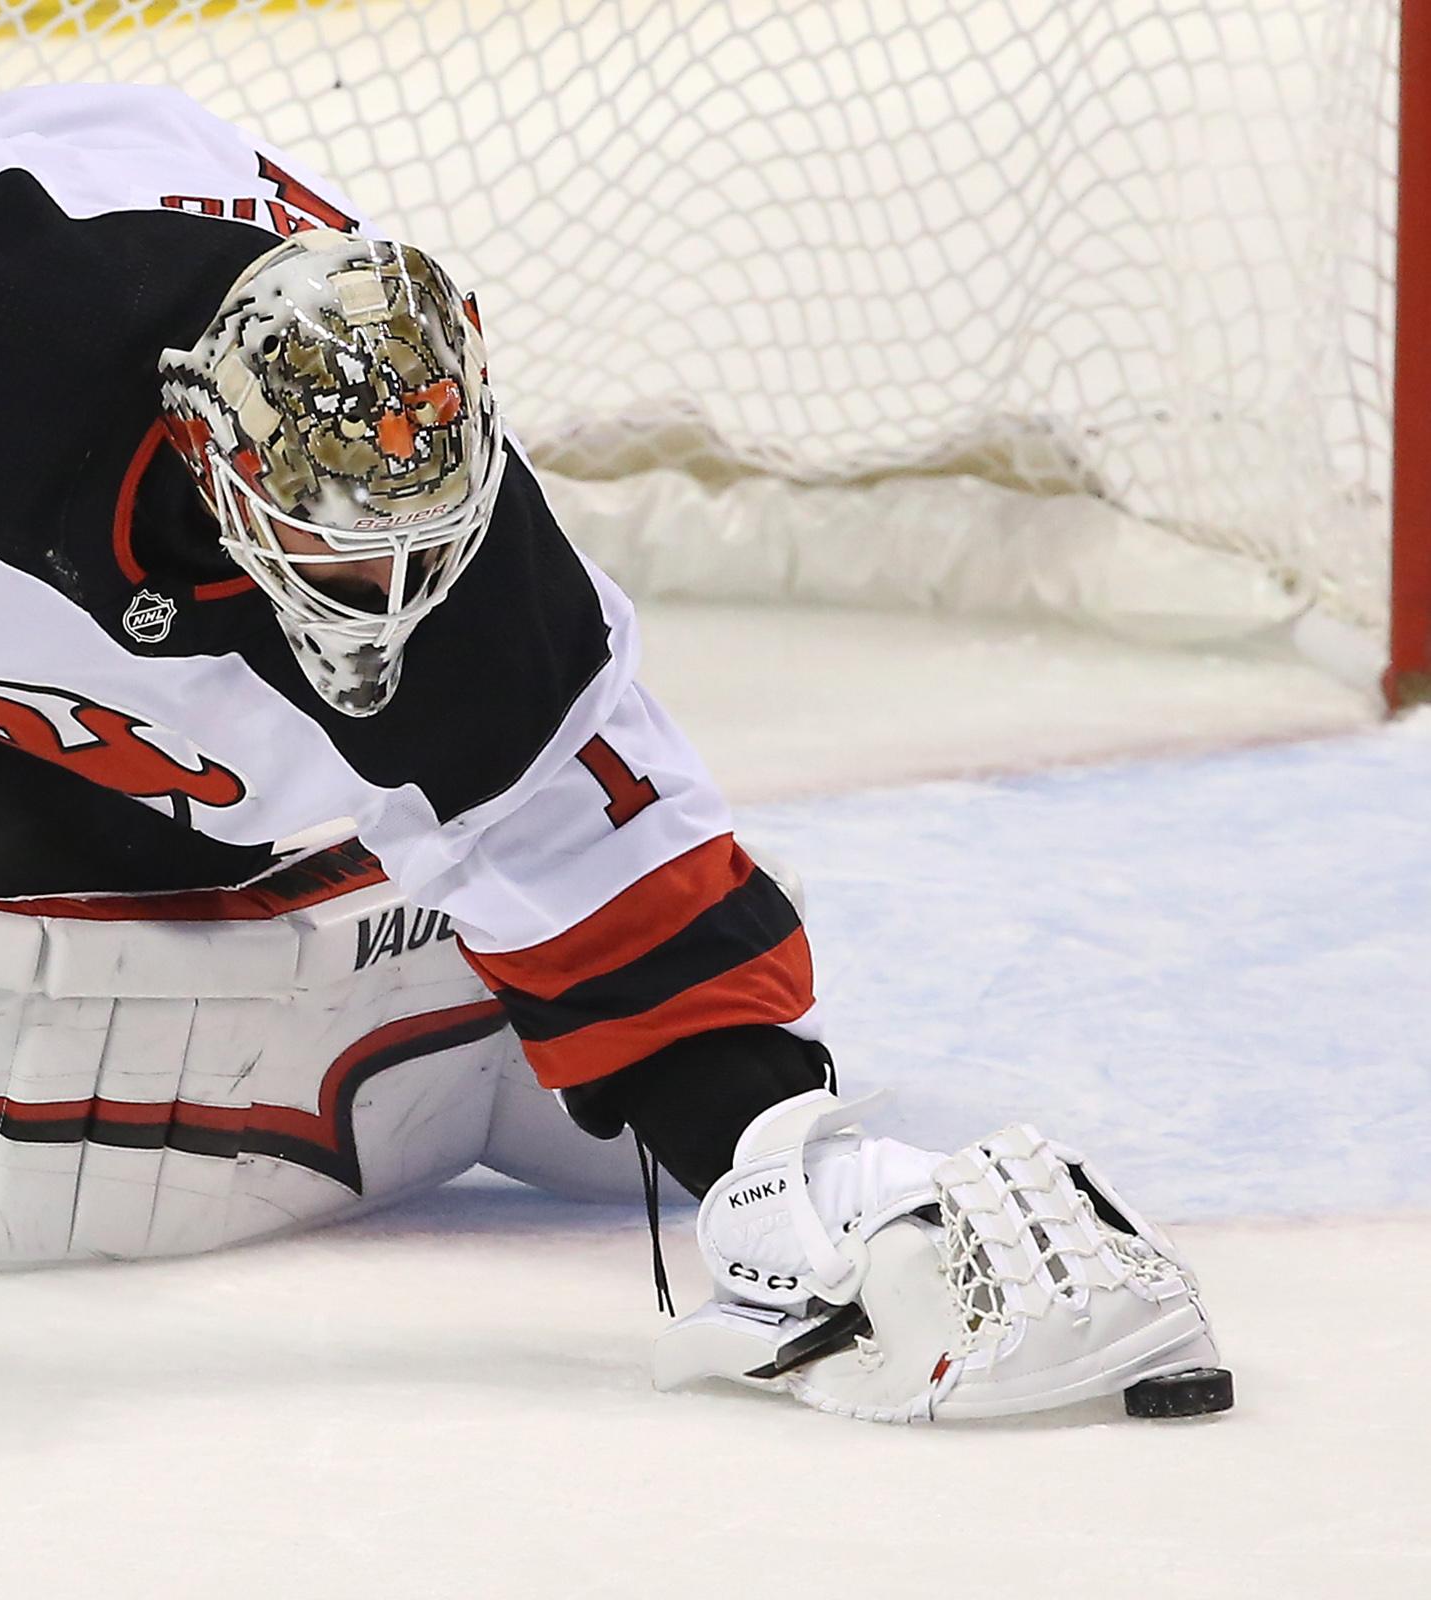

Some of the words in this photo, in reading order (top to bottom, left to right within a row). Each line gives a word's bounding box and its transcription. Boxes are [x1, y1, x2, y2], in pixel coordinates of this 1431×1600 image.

[353, 503, 448, 530] BAUER
[132, 609, 164, 627] NHL
[574, 732, 661, 830] 1
